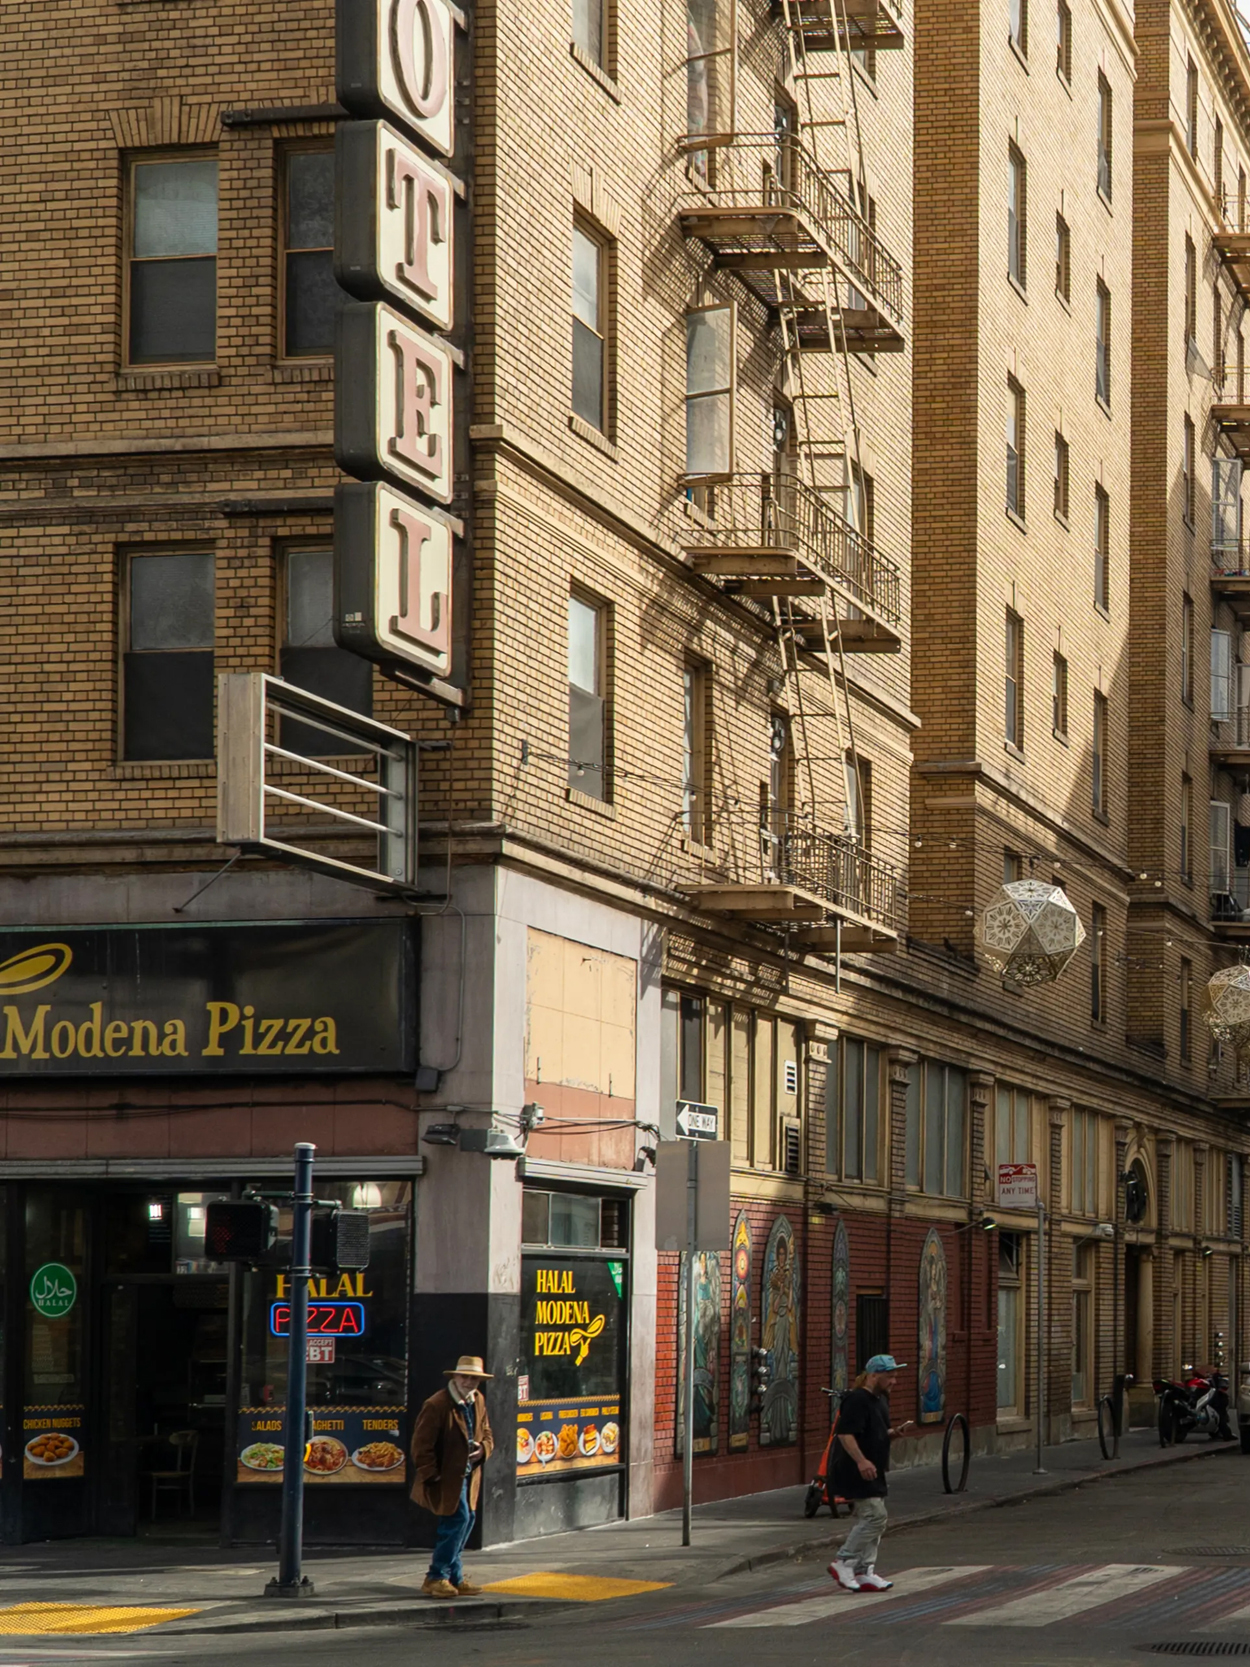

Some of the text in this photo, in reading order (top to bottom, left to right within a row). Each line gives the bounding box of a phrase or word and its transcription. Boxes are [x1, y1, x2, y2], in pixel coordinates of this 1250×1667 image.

[0, 1001, 340, 1059] Modena Pizza
[688, 1113, 715, 1131] ONE WAY
[1002, 1187, 1034, 1195] ANY TIME
[35, 1276, 73, 1299] حلال
[536, 1269, 576, 1294] HALAL
[275, 1307, 359, 1333] PZZA
[534, 1300, 591, 1325] MODENA
[308, 1339, 333, 1347] ACCEPT
[534, 1331, 571, 1356] PIZZA
[306, 1346, 333, 1361] BT
[23, 1417, 82, 1430] CHICKEN NUGGETS
[251, 1419, 399, 1431] SALADS AGHETTI TENDERS
